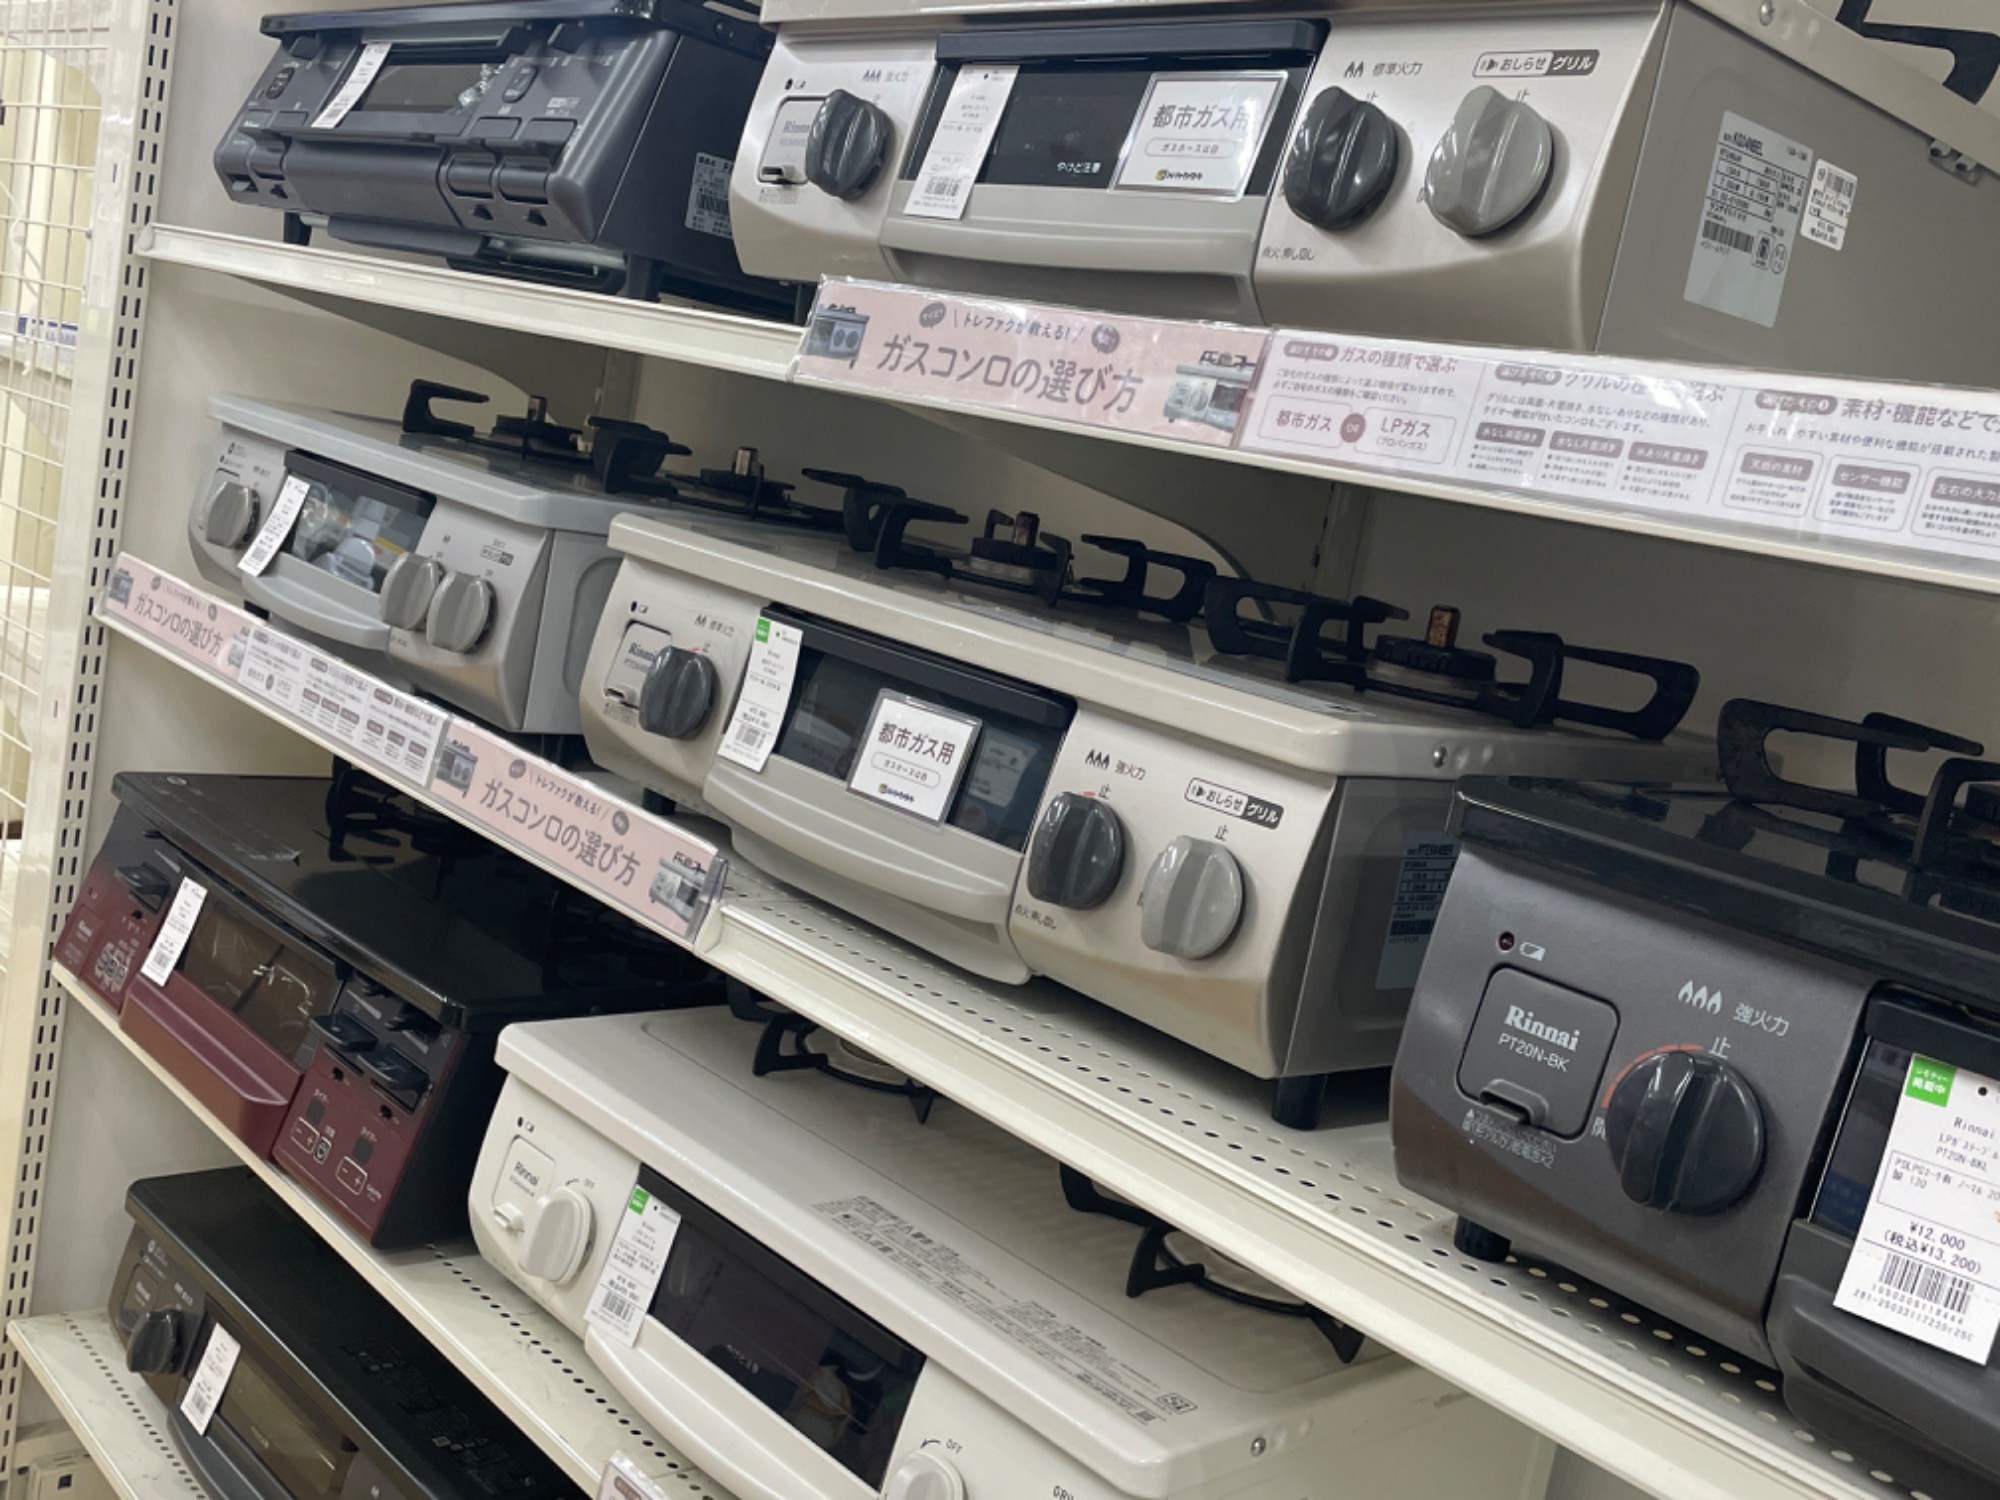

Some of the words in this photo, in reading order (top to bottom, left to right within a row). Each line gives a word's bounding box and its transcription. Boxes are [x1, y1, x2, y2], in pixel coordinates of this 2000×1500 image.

[1499, 56, 1547, 71] おしらせ
[1552, 55, 1594, 71] グリル
[1340, 346, 1459, 374] ガスの種類で選ぶ
[876, 333, 1144, 414] ガスコンロの選び方
[1275, 409, 1332, 432] 都市ガス
[1380, 417, 1432, 439] LPガス
[1840, 397, 2000, 433] 素材・機能などで
[1935, 482, 2000, 502] 左右の火力
[134, 592, 224, 658] ガスコンロの選び方
[878, 721, 956, 766] 都市ガス用
[1115, 759, 1147, 781] 強火力
[1098, 783, 1112, 800] 止
[1205, 789, 1244, 812] おしらせ
[1247, 803, 1280, 824] グリル
[479, 778, 642, 888] ガスコンロの選び方
[1214, 824, 1229, 842] 止
[1504, 1003, 1582, 1052] Rinnai
[1731, 1004, 1790, 1037] 強火力
[1498, 1032, 1571, 1073] PT20N-BK
[1709, 1036, 1731, 1061] 止
[1911, 1076, 1947, 1095] 掲載中
[1953, 1116, 1995, 1139] Rinnai
[1909, 1220, 1967, 1252] ¥12,000
[945, 1438, 964, 1454] OFF
